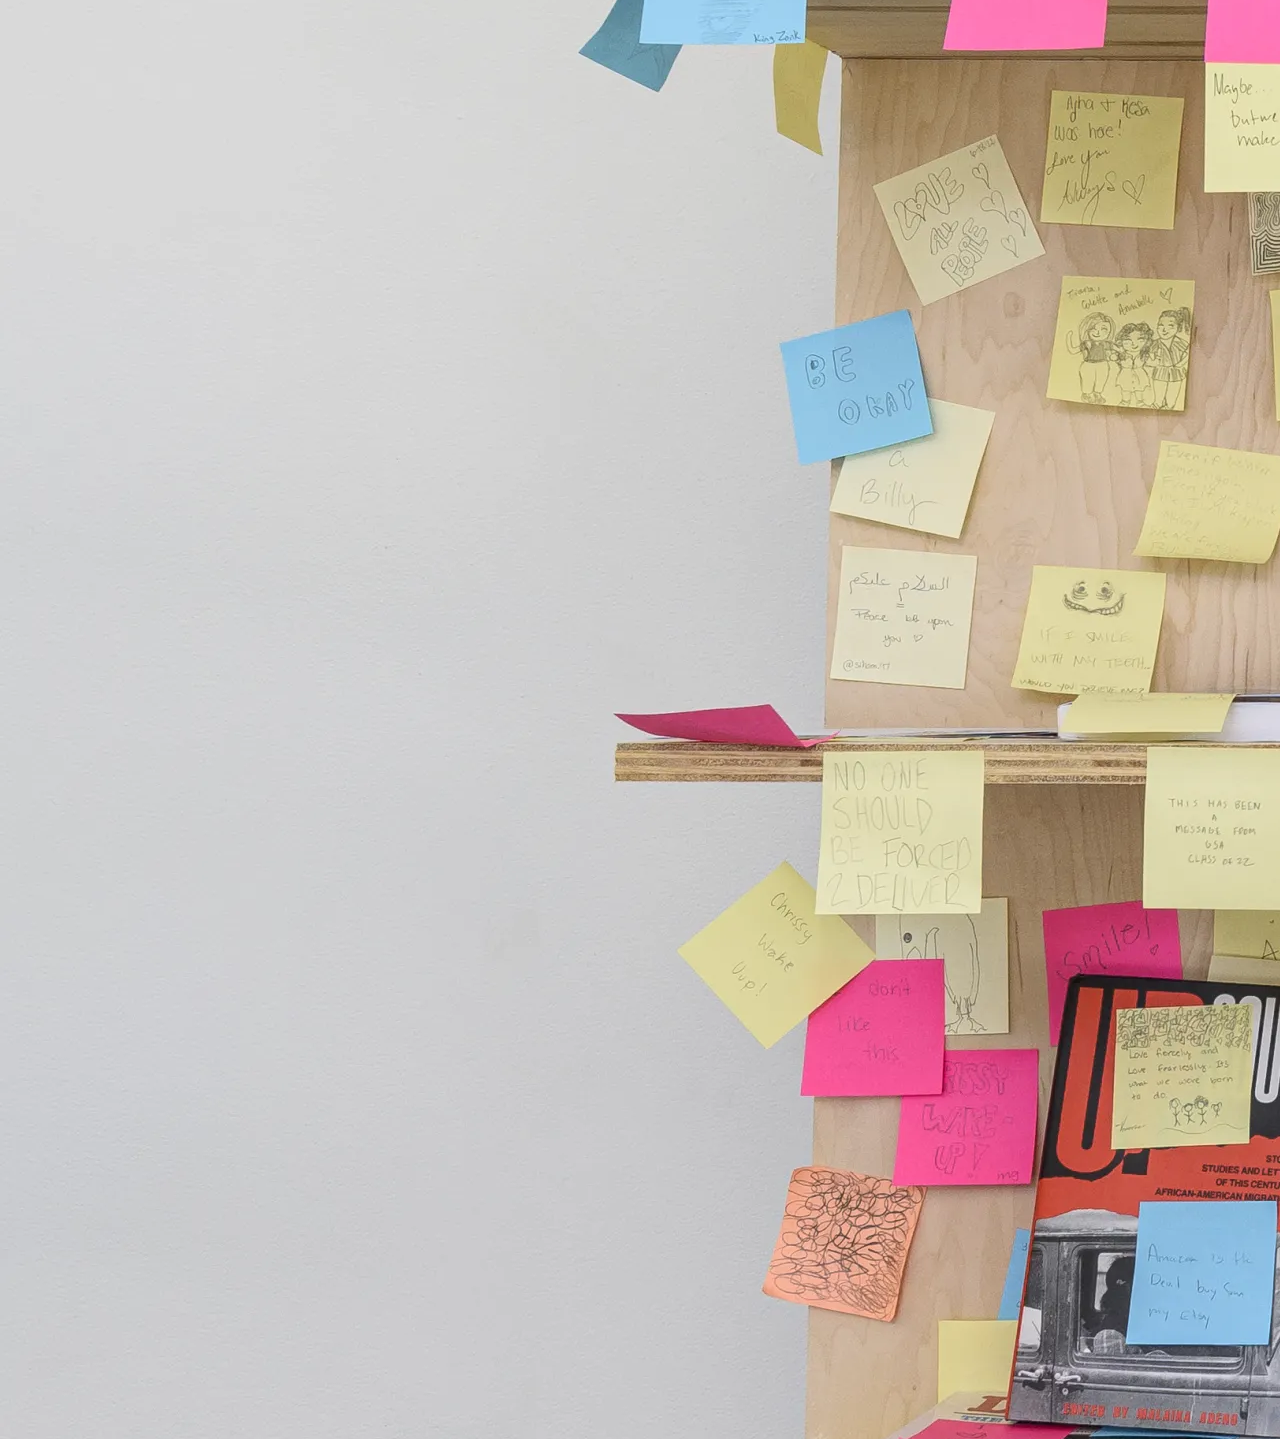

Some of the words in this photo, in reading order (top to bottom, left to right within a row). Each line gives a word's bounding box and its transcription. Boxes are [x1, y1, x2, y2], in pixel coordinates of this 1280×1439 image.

[834, 761, 865, 791] NO
[882, 758, 928, 792] ONE
[833, 796, 933, 834] SHOULD
[831, 836, 863, 865] BE
[882, 837, 971, 870] FORCED
[827, 873, 849, 906] 2
[856, 873, 968, 911] DELIVER
[1202, 1164, 1239, 1174] STUDIES
[1241, 1167, 1260, 1175] AND
[1155, 1188, 1242, 1200] AFRICAN-AMERICAN
